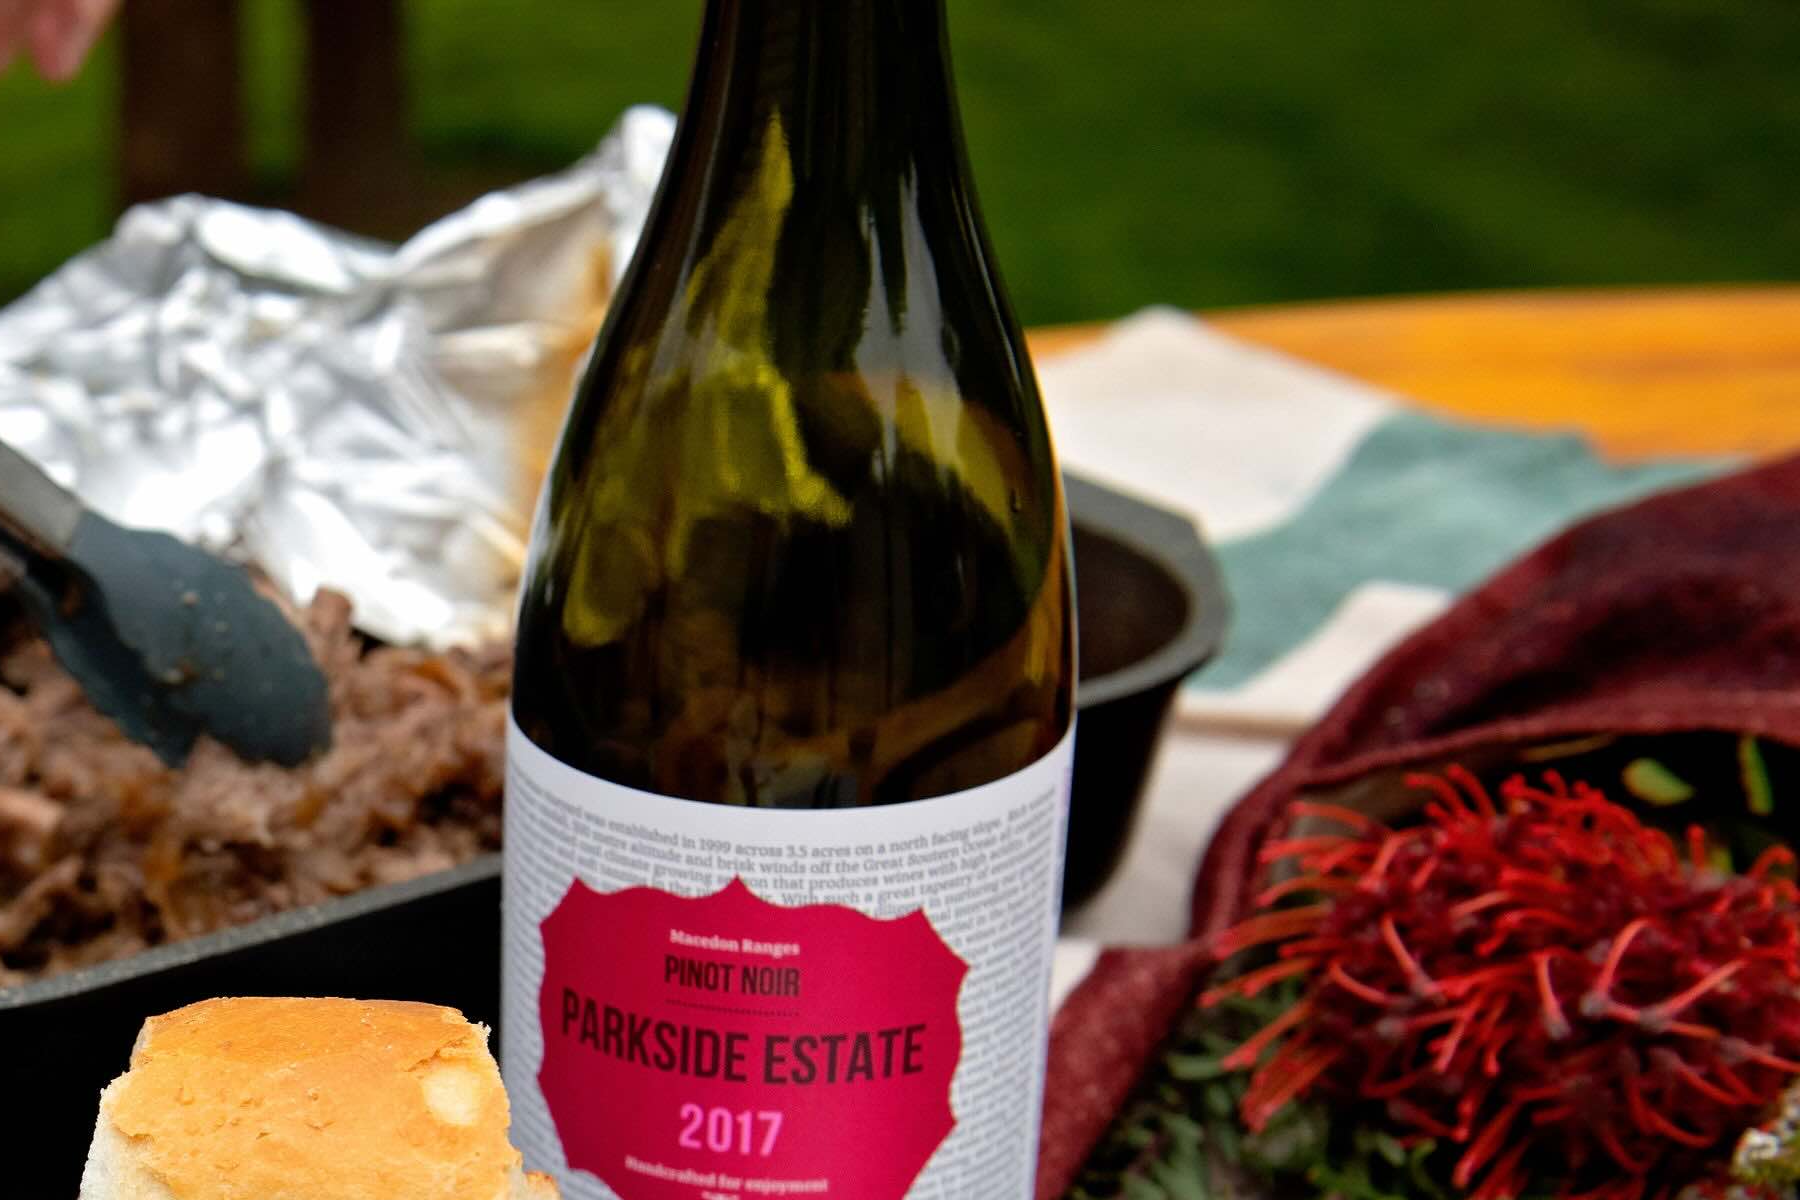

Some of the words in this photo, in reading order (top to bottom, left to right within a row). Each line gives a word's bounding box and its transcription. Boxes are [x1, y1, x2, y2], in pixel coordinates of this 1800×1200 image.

[701, 838, 731, 852] 1999
[735, 843, 783, 857] across
[811, 845, 850, 857] acres
[855, 844, 874, 856] on
[889, 835, 928, 852] north
[686, 853, 712, 868] and
[717, 855, 756, 872] brisk
[760, 860, 806, 873] winds
[810, 859, 832, 874] off
[835, 859, 860, 872] the
[863, 857, 904, 872] Great
[772, 876, 804, 890] that
[809, 874, 879, 894] produces
[883, 870, 924, 884] wines
[878, 885, 916, 904] great
[669, 929, 739, 952] Macedon
[742, 938, 800, 958] Ranges
[664, 953, 735, 992] PINOT
[740, 965, 800, 998] NOIR
[561, 986, 749, 1083] PARKSIDE
[763, 1023, 927, 1085] ESTATE
[679, 1103, 783, 1156] 2017
[625, 1154, 716, 1187] Handcrafted
[719, 1173, 741, 1190] for
[745, 1175, 829, 1195] enjoyment
